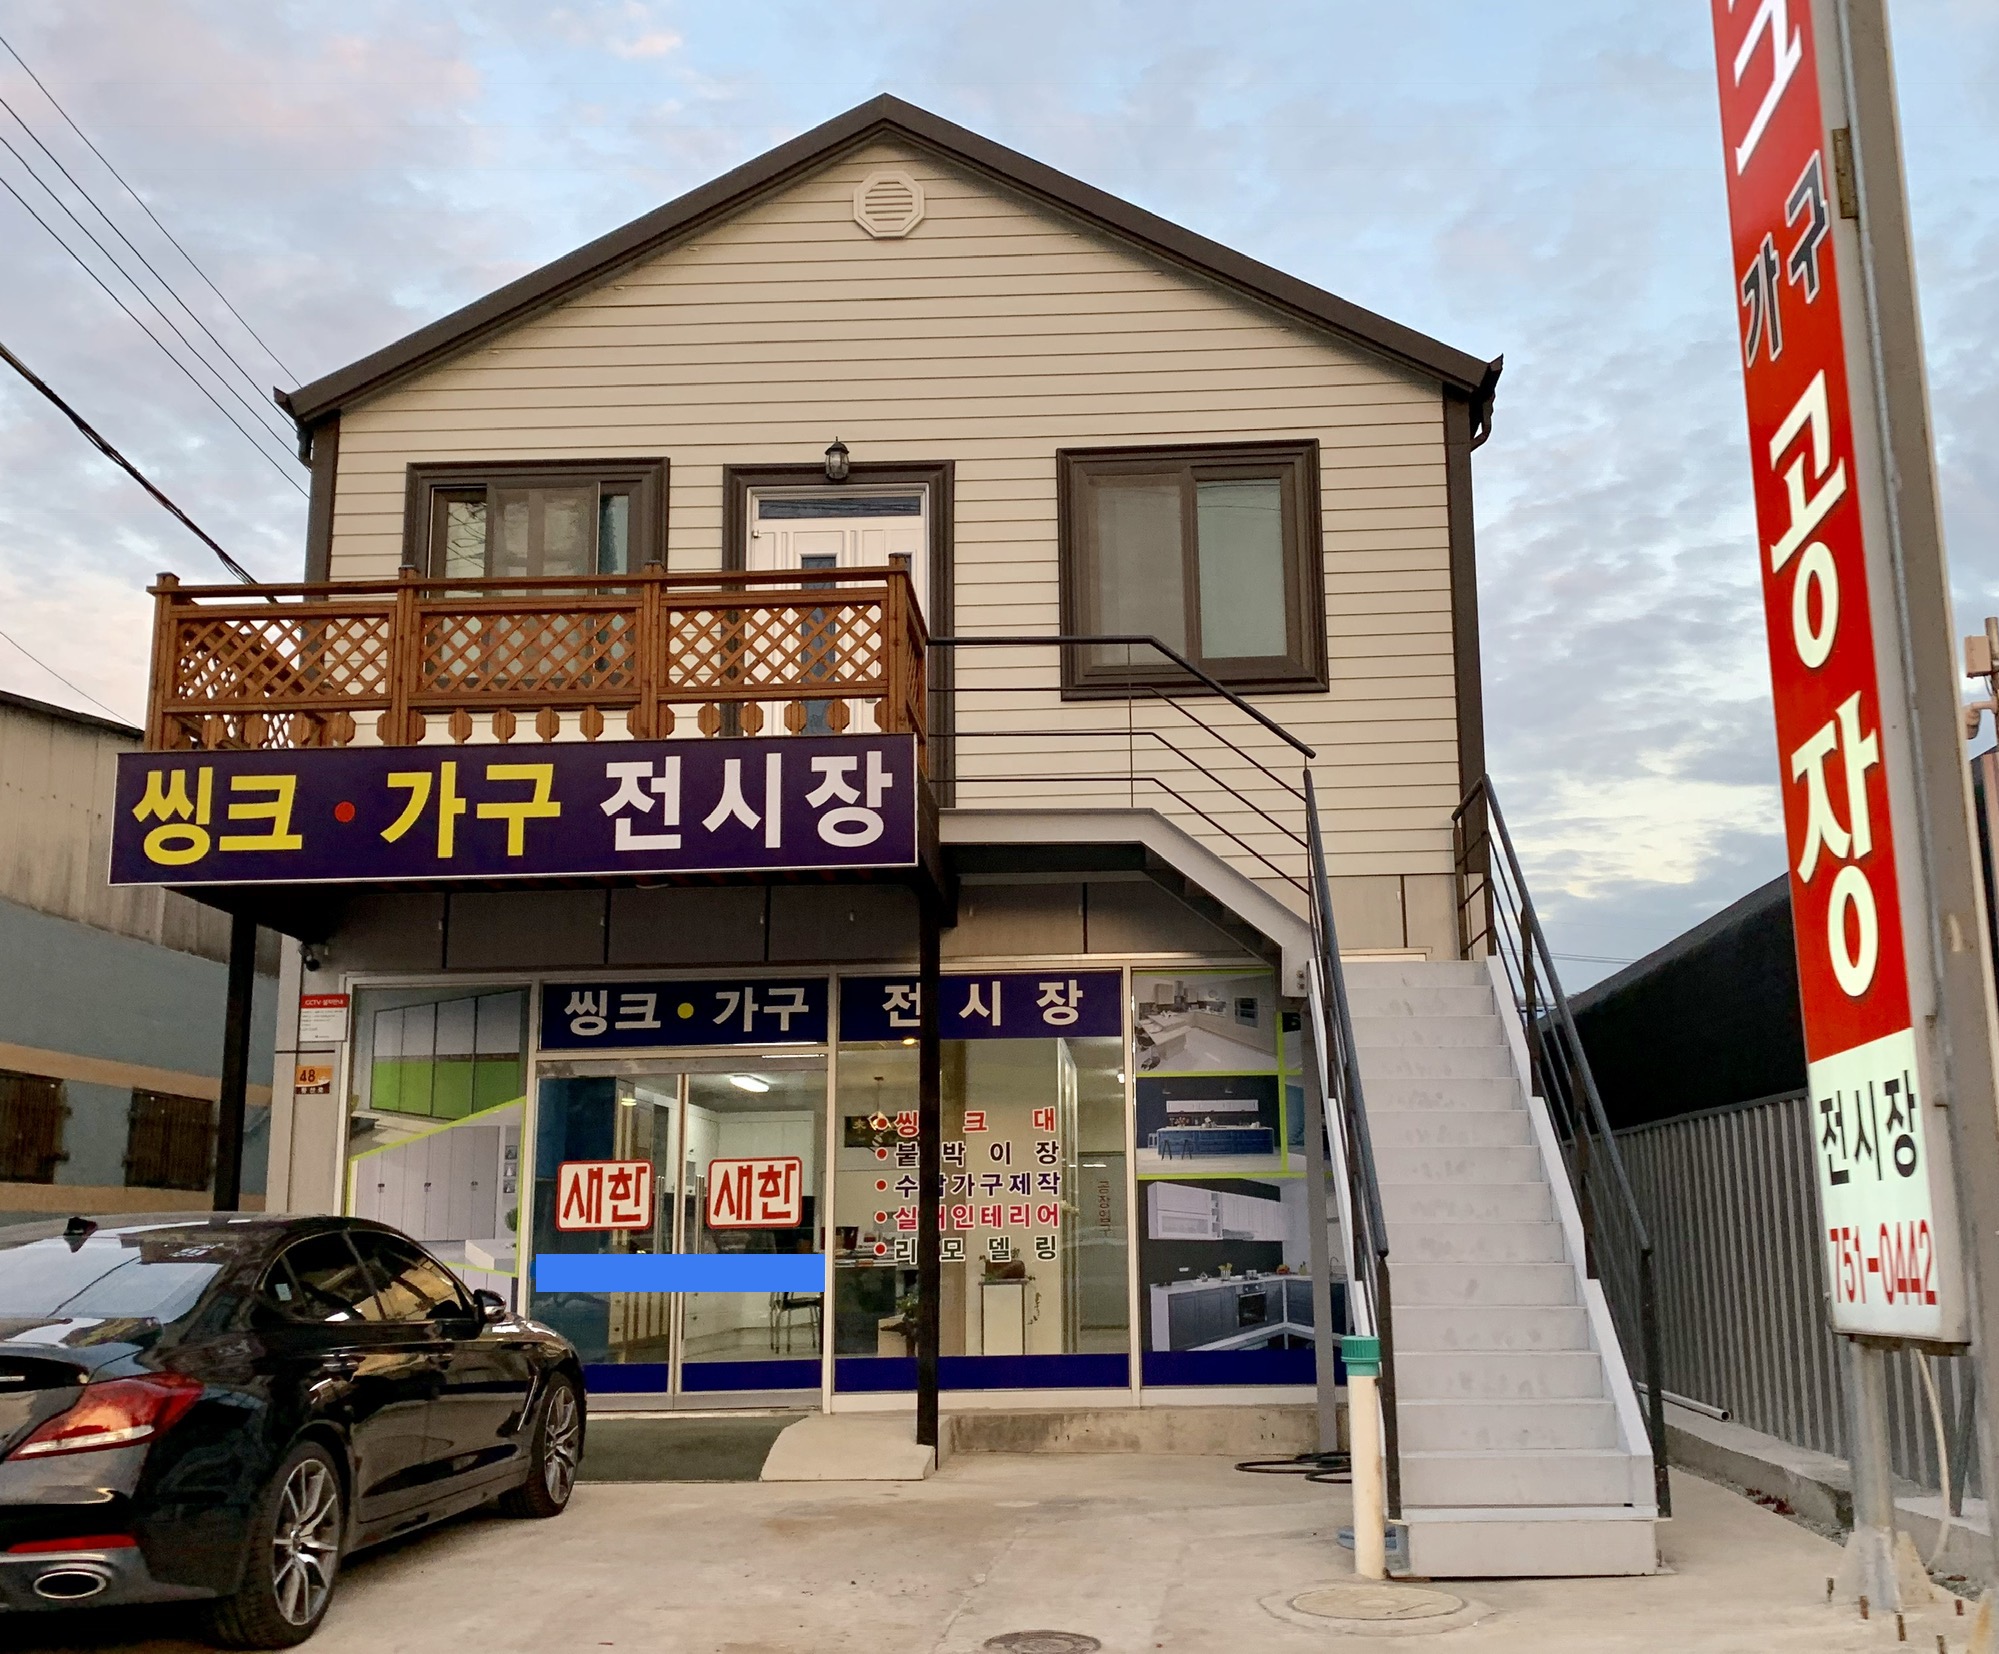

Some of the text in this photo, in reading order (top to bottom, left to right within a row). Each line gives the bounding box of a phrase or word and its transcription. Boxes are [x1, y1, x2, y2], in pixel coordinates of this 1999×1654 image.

[1742, 149, 1830, 369] 가구
[1769, 369, 1880, 997] 공장
[132, 750, 893, 866] 씽크 가구 전시장
[564, 986, 809, 1036] 씽크 가구
[299, 1069, 315, 1082] 48
[1819, 1069, 1917, 1186] 전시장
[561, 1165, 648, 1224] 새한
[713, 1163, 798, 1222] 새한
[894, 1203, 1060, 1230] 실인테리어
[1829, 1219, 1939, 1305] 751-0442
